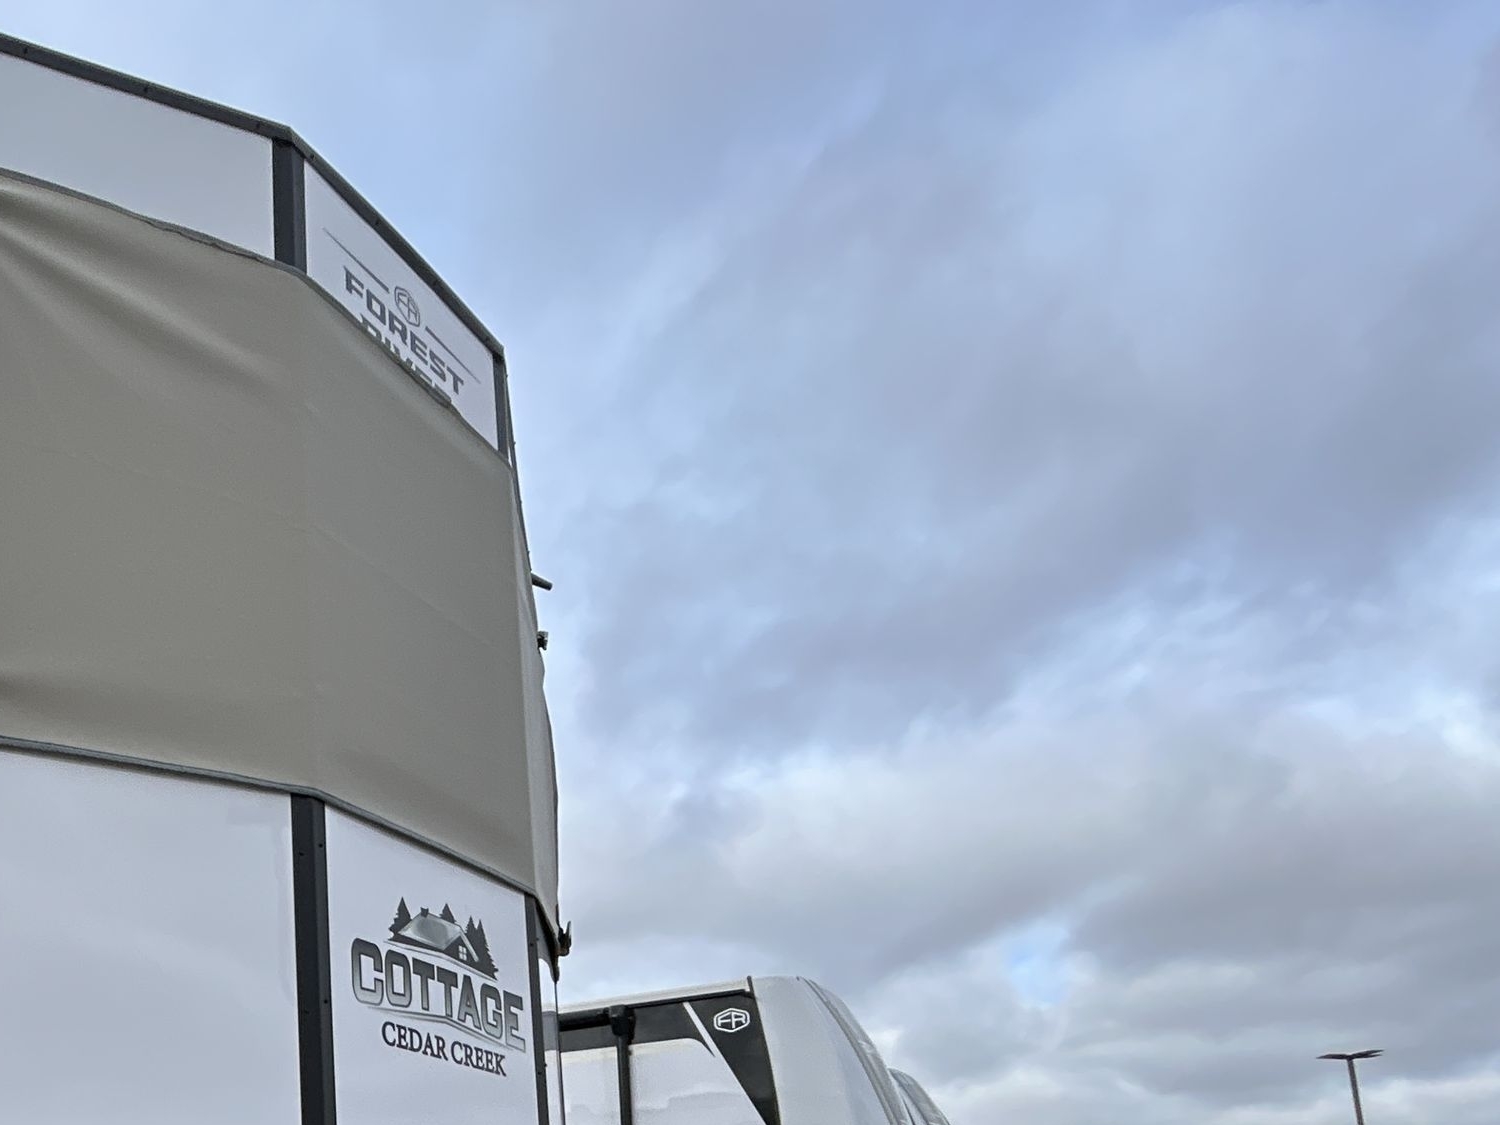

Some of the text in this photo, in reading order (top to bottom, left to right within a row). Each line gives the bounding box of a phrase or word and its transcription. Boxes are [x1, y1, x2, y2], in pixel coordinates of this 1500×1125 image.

[343, 265, 464, 395] FOREST
[351, 937, 526, 1052] COTTAGE
[381, 1021, 507, 1077] CEDAR CREEK
